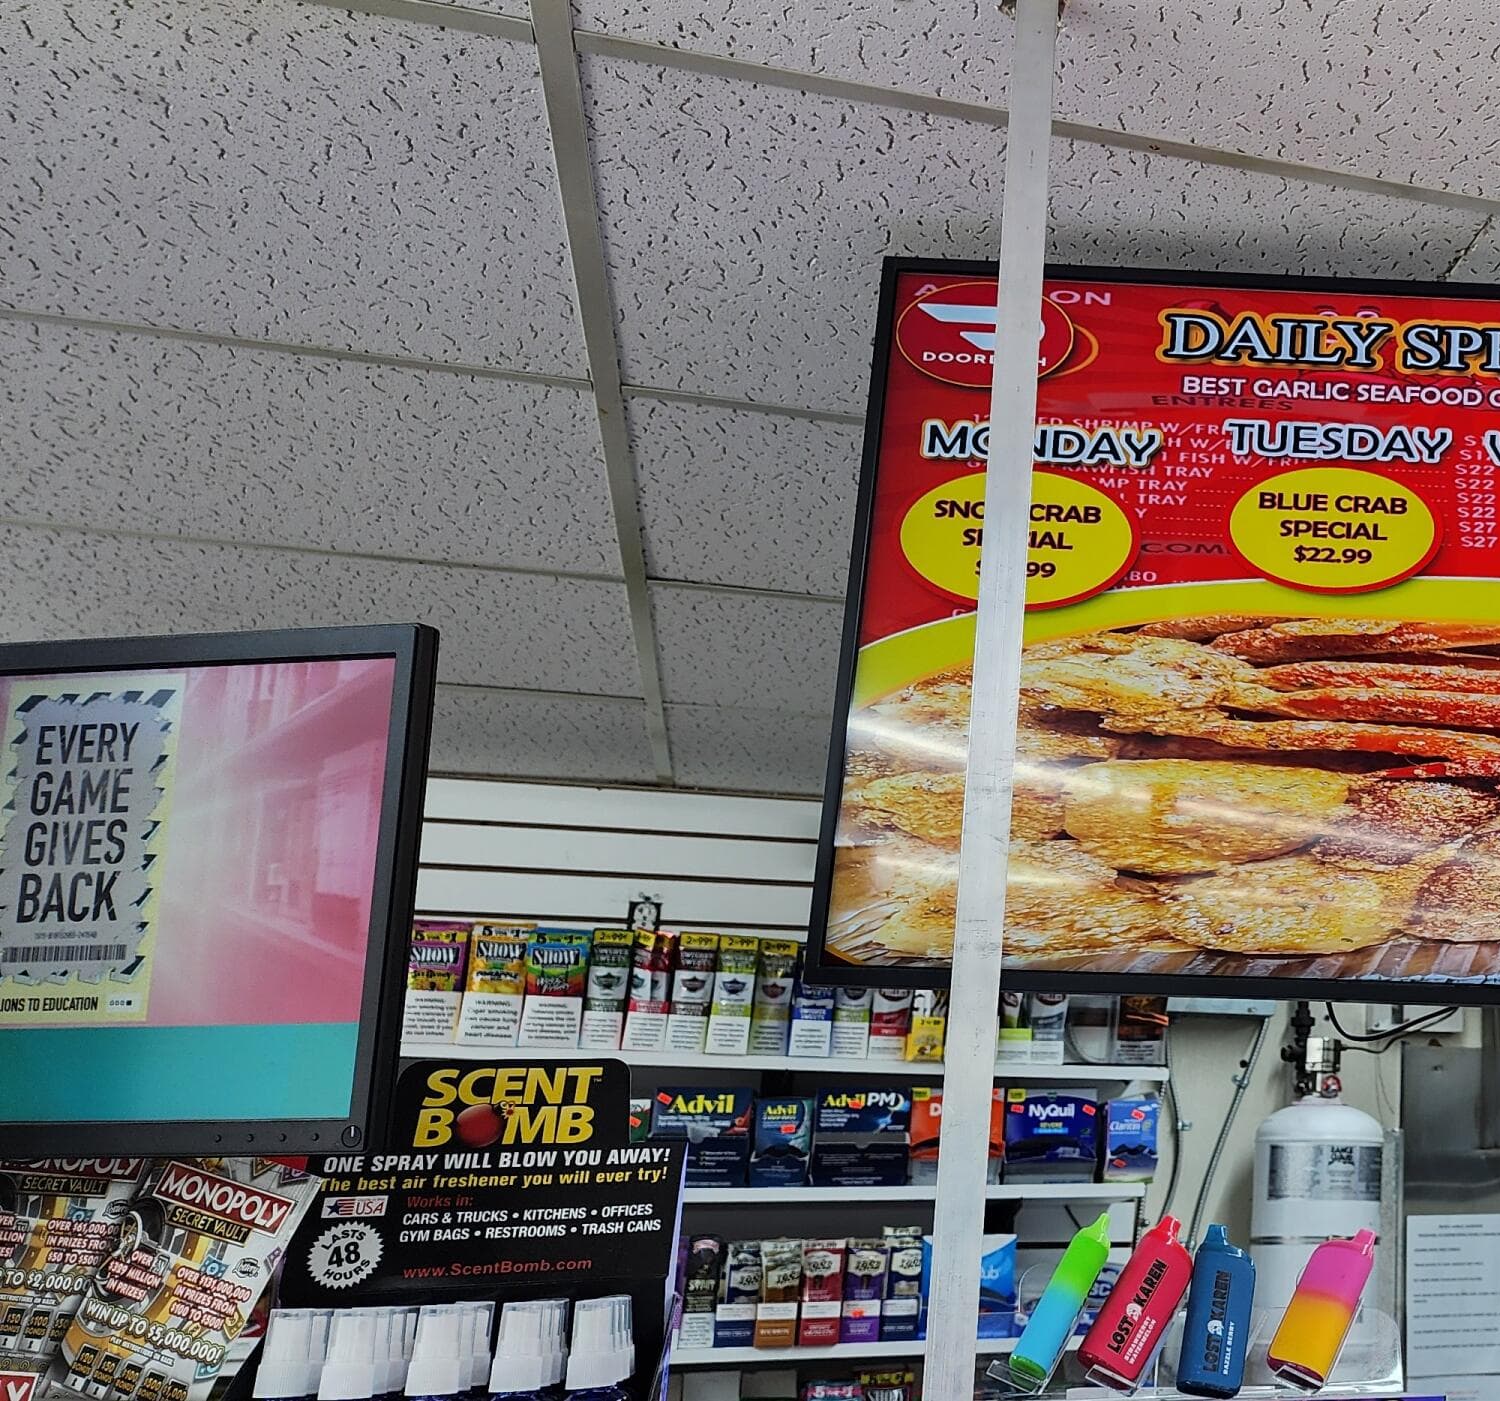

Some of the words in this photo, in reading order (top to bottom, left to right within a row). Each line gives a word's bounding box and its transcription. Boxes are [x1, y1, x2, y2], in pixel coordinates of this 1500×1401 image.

[1163, 311, 1389, 368] DAILY
[1182, 375, 1247, 397] BEST
[1252, 378, 1351, 403] GARLIC
[1356, 382, 1483, 409] SEAFOOD
[1224, 417, 1453, 464] TUESDAY
[1178, 451, 1226, 465] FISH
[1165, 465, 1214, 479] TRAY
[1138, 479, 1189, 492] TRAY
[1137, 493, 1188, 506] TRAY
[1258, 491, 1329, 513] BLUE
[1334, 494, 1409, 516] CRAB
[934, 500, 986, 519] SNO
[1029, 503, 1102, 524] CRAB
[1278, 519, 1389, 542] SPECIAL
[1292, 544, 1373, 565] $22.99
[35, 721, 141, 766] EVERY
[29, 768, 135, 816] GAME
[23, 818, 129, 867] GIVES
[16, 869, 119, 924] BACK
[27, 998, 41, 1012] TO
[42, 997, 99, 1012] EDUCATION
[422, 1067, 603, 1107] SCENT
[669, 1094, 735, 1115] Advil
[764, 1104, 798, 1117] Advil
[866, 1092, 896, 1107] PM
[1028, 1103, 1076, 1119] NyQuil
[323, 1155, 364, 1174] ONE
[371, 1154, 438, 1173] SPRAY
[443, 1152, 492, 1170] WILL
[498, 1150, 558, 1169] BLOW
[563, 1149, 604, 1167] YOU
[605, 1148, 671, 1165] AWAY!
[23, 1177, 69, 1191] SECRET
[69, 1180, 108, 1194] VAULT
[320, 1176, 355, 1193] The
[360, 1175, 397, 1192] best
[402, 1174, 426, 1190] air
[432, 1171, 518, 1188] freshener
[522, 1174, 553, 1191] you
[558, 1168, 590, 1186] will
[595, 1170, 633, 1184] ever
[636, 1166, 668, 1185] try!
[159, 1170, 289, 1231] MONOPOLY
[354, 1200, 386, 1217] USA
[407, 1194, 451, 1209] Works
[454, 1193, 474, 1208] in:
[47, 1220, 72, 1231] OVER
[170, 1205, 214, 1232] SECRET
[212, 1219, 250, 1242] VAULT
[402, 1211, 439, 1226] CARS
[441, 1210, 452, 1224] &
[456, 1208, 508, 1224] TRUCKS
[522, 1206, 588, 1222] KITCHENS
[601, 1203, 654, 1219] OFFICES
[321, 1229, 367, 1251] LASTS
[399, 1228, 432, 1243] GYM
[433, 1227, 471, 1242] BAGS
[485, 1224, 567, 1240] RESTROOMS
[581, 1221, 624, 1236] TRASH
[626, 1218, 662, 1233] CANS
[46, 1236, 57, 1247] IN
[58, 1238, 88, 1249] PRIZES
[88, 1240, 112, 1251] FRO
[327, 1240, 361, 1268] 48
[65, 1252, 78, 1262] TO
[131, 1250, 154, 1267] OVER
[403, 1256, 593, 1280] www.ScentBomb.com
[5, 1271, 25, 1285] TO
[127, 1266, 162, 1289] MILLION
[322, 1257, 372, 1282] HOURS
[105, 1279, 118, 1292] IN
[118, 1281, 147, 1301] PRIZES!
[177, 1267, 200, 1283] OVER
[199, 1274, 251, 1301] $131,000,000
[1209, 1269, 1232, 1322] KAREN
[173, 1285, 184, 1297] IN
[183, 1287, 211, 1308] PRIZES
[210, 1297, 237, 1316] FROM
[1107, 1314, 1136, 1354] LOST
[1133, 1257, 1169, 1308] KAREN
[170, 1301, 188, 1316] $100
[188, 1306, 201, 1321] TO
[201, 1312, 224, 1330] $500!
[86, 1300, 111, 1321] WIN
[110, 1310, 129, 1327] UP
[128, 1317, 148, 1335] TO
[148, 1323, 224, 1363] $5,000,000!
[1203, 1333, 1223, 1373] LOST
